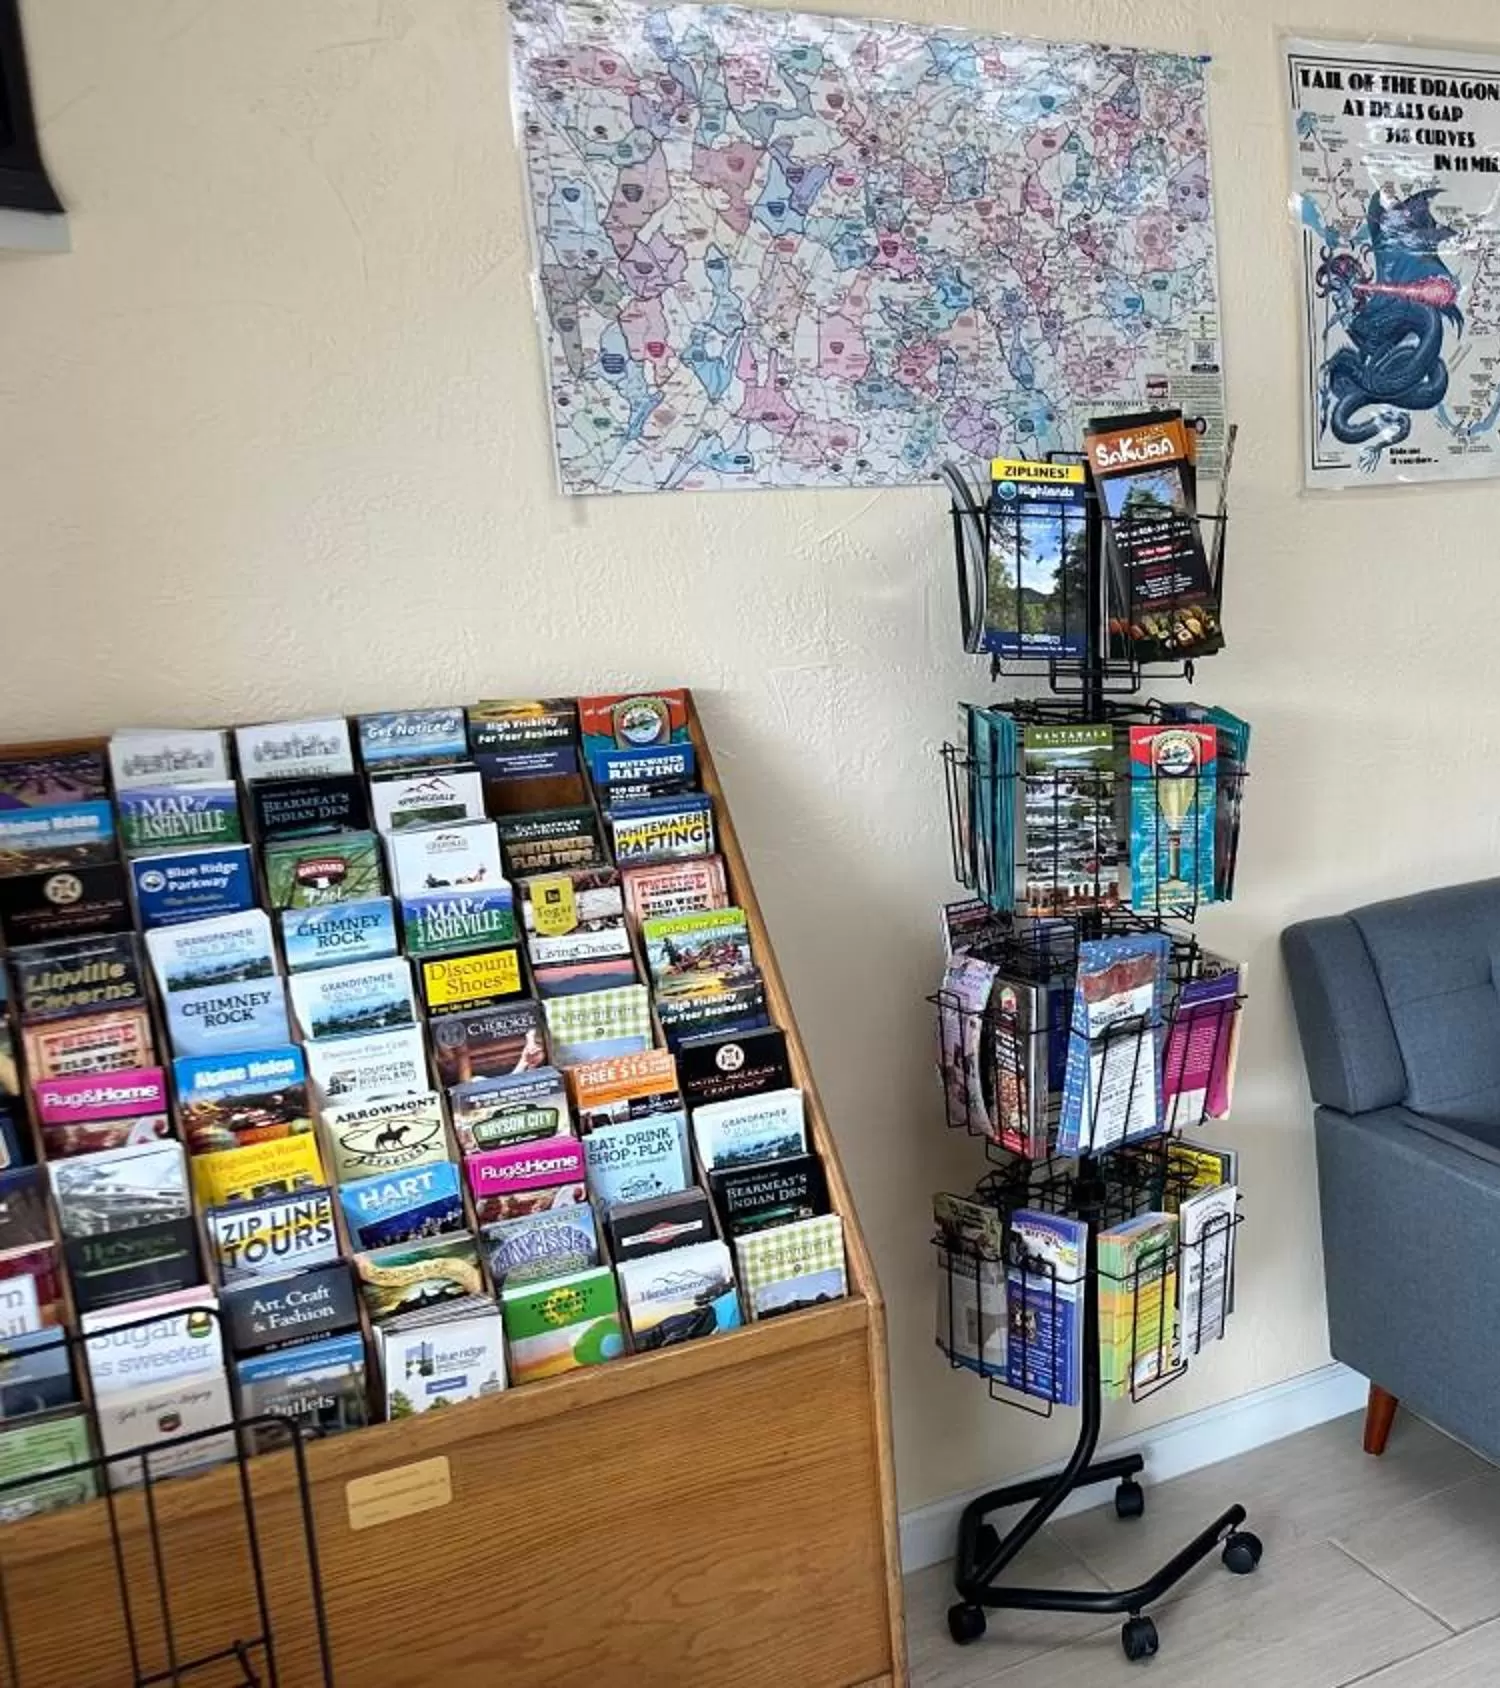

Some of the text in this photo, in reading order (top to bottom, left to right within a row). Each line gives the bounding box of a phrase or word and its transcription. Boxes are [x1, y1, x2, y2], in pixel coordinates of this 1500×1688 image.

[1300, 69, 1343, 89] TAIL
[1350, 73, 1375, 91] OF
[1379, 75, 1416, 95] THE
[1342, 99, 1365, 117] AT
[1428, 104, 1463, 123] GAP
[1416, 129, 1476, 148] CURVES
[1434, 154, 1452, 170] IN
[1454, 155, 1469, 172] 11
[1003, 465, 1070, 479] ZIPLINES!
[367, 726, 393, 740] Get
[478, 733, 497, 745] For
[499, 732, 523, 742] Your
[607, 763, 686, 781] RAFTING
[141, 795, 194, 817] MAP
[264, 803, 350, 827] INDIAN DEN
[141, 808, 227, 840] ASHEVILLE
[615, 812, 703, 839] WHITEWATER
[617, 825, 704, 858] RAFTING
[165, 862, 240, 879] Blue Ridge
[167, 877, 230, 893] Parkway
[425, 897, 473, 922] MAP
[297, 913, 383, 937] CHIMNEY
[425, 908, 503, 943] ASHEVILLE
[316, 928, 367, 949] ROCK
[25, 961, 127, 994] Linville
[430, 955, 516, 982] Discount
[24, 981, 137, 1014] Caverns
[447, 974, 503, 996] Shoes
[181, 991, 273, 1017] CHIMNEY
[203, 1008, 256, 1029] ROCK
[580, 1067, 616, 1089] FREE
[43, 1085, 159, 1110] Rug&Home
[336, 1096, 437, 1125] ARROWMONT
[480, 1111, 554, 1138] BRYSON CITY
[588, 1126, 672, 1152] EAT DRINK
[588, 1146, 631, 1166] SHOP
[638, 1139, 674, 1158] PLAY
[480, 1154, 579, 1179] Rug&Home
[358, 1176, 434, 1211] HART
[727, 1185, 808, 1213] INDIAN DEN
[221, 1196, 331, 1246] ZIP LINE
[224, 1223, 333, 1269] TOURS
[285, 1284, 333, 1307] Craft
[267, 1304, 336, 1330] Fashion
[116, 1343, 214, 1374] sweeter
